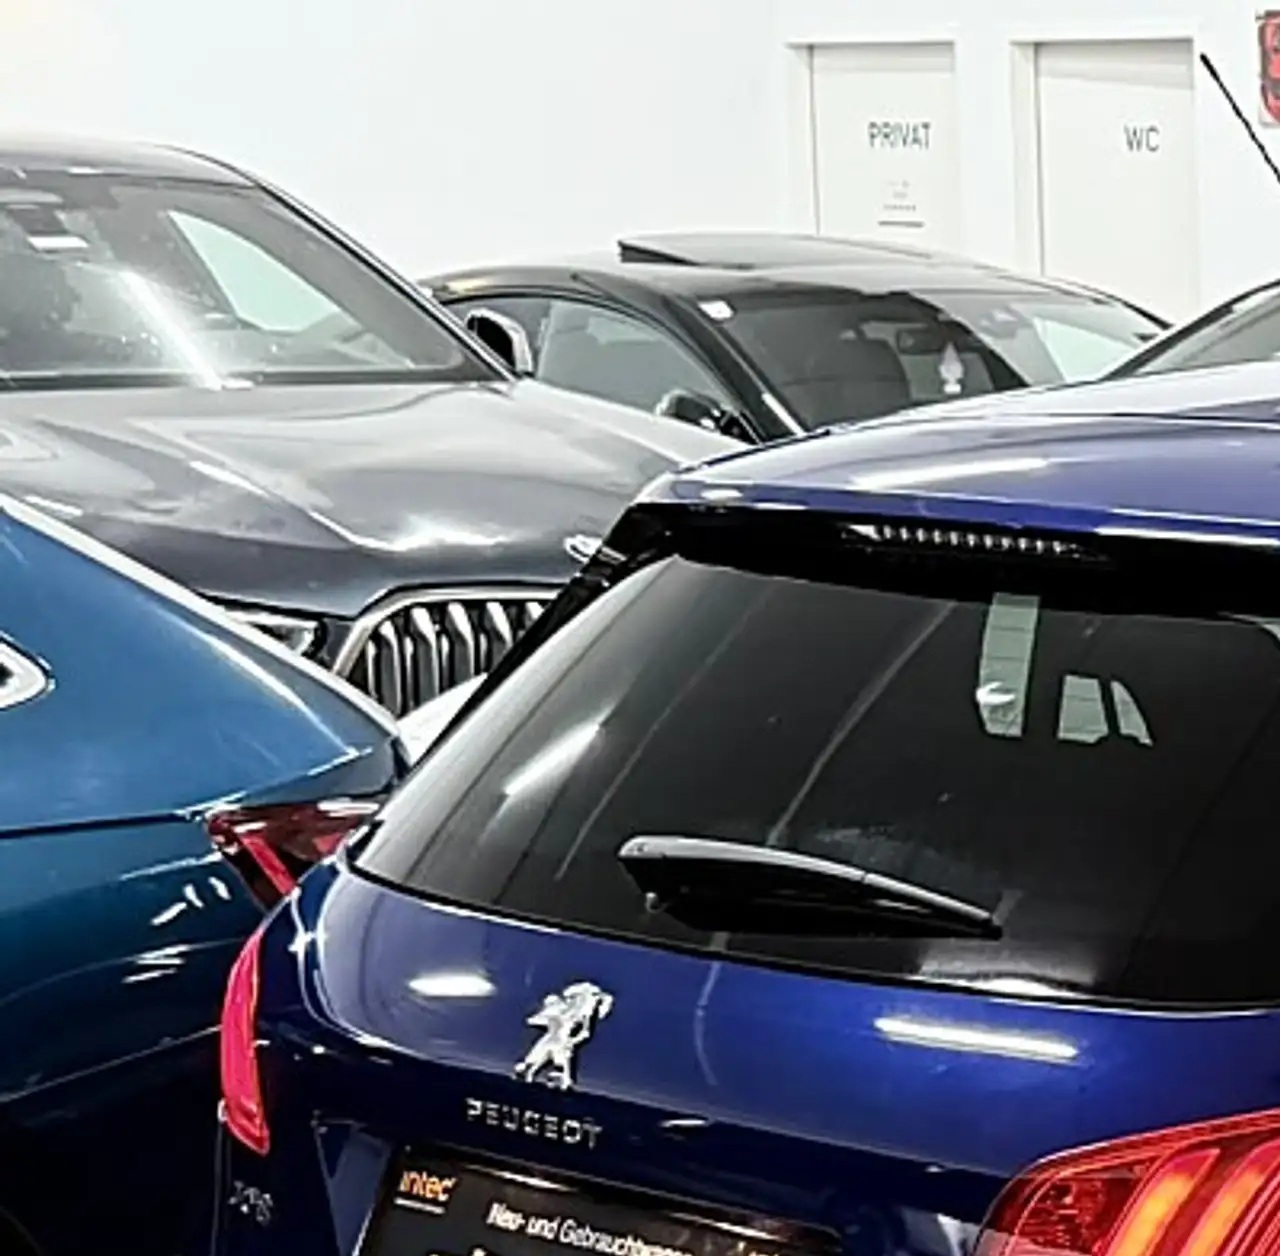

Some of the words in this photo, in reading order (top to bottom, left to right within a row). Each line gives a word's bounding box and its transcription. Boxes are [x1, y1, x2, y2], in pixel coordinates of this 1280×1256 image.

[867, 121, 931, 150] PRIVAT
[1124, 124, 1161, 152] WC
[465, 1097, 603, 1149] PEUGEOT
[525, 1215, 561, 1241] und
